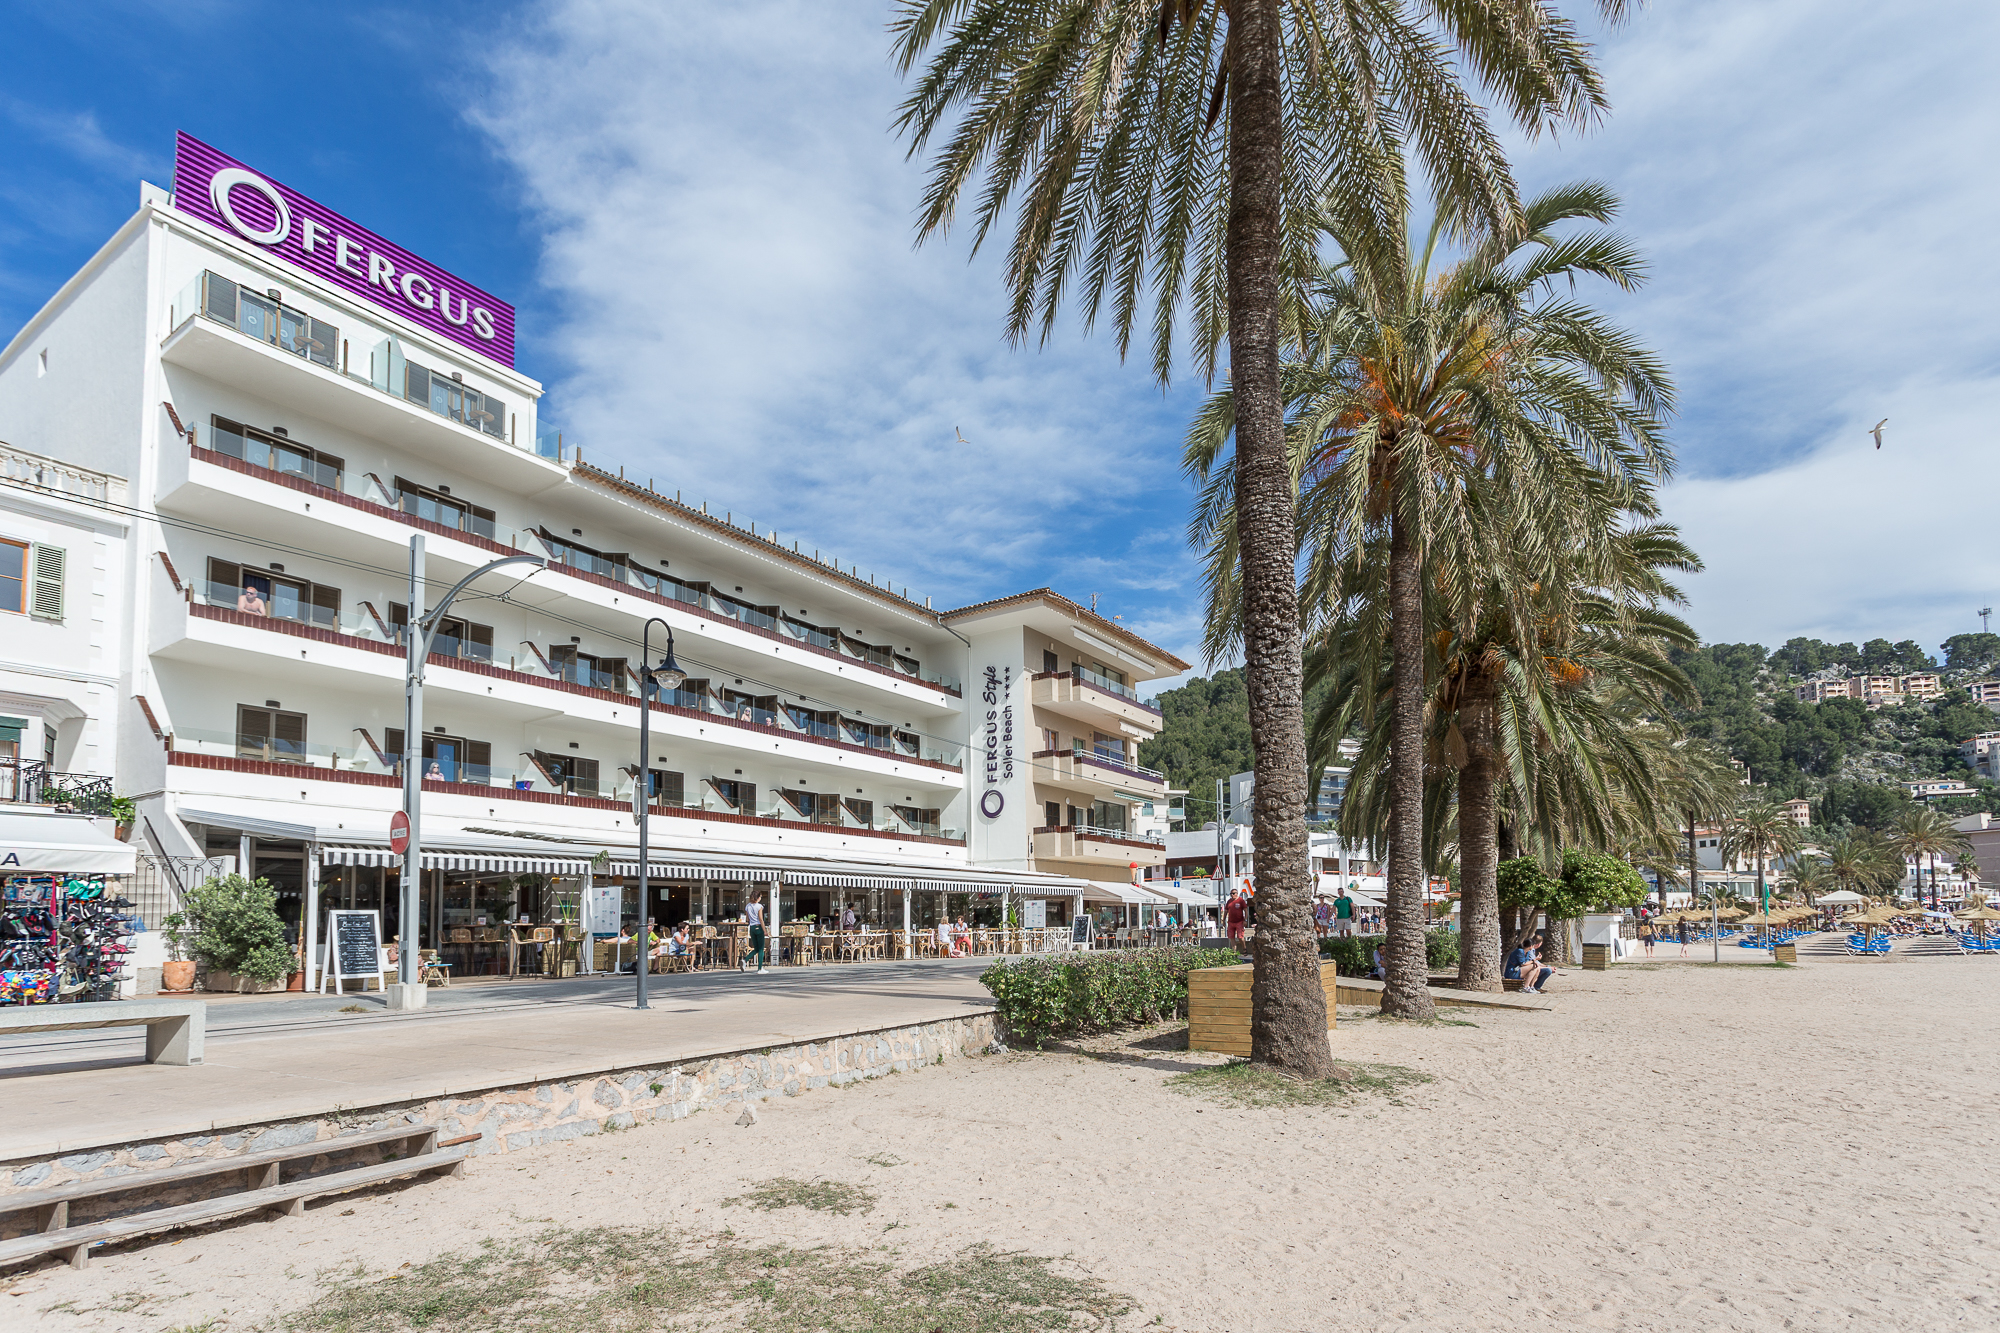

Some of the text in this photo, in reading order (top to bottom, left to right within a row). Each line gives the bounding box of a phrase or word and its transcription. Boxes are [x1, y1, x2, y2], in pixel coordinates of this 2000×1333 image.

[302, 216, 496, 340] FERGUS
[983, 665, 1002, 783] FERGUS Style
[1003, 705, 1013, 779] Soller Beach
